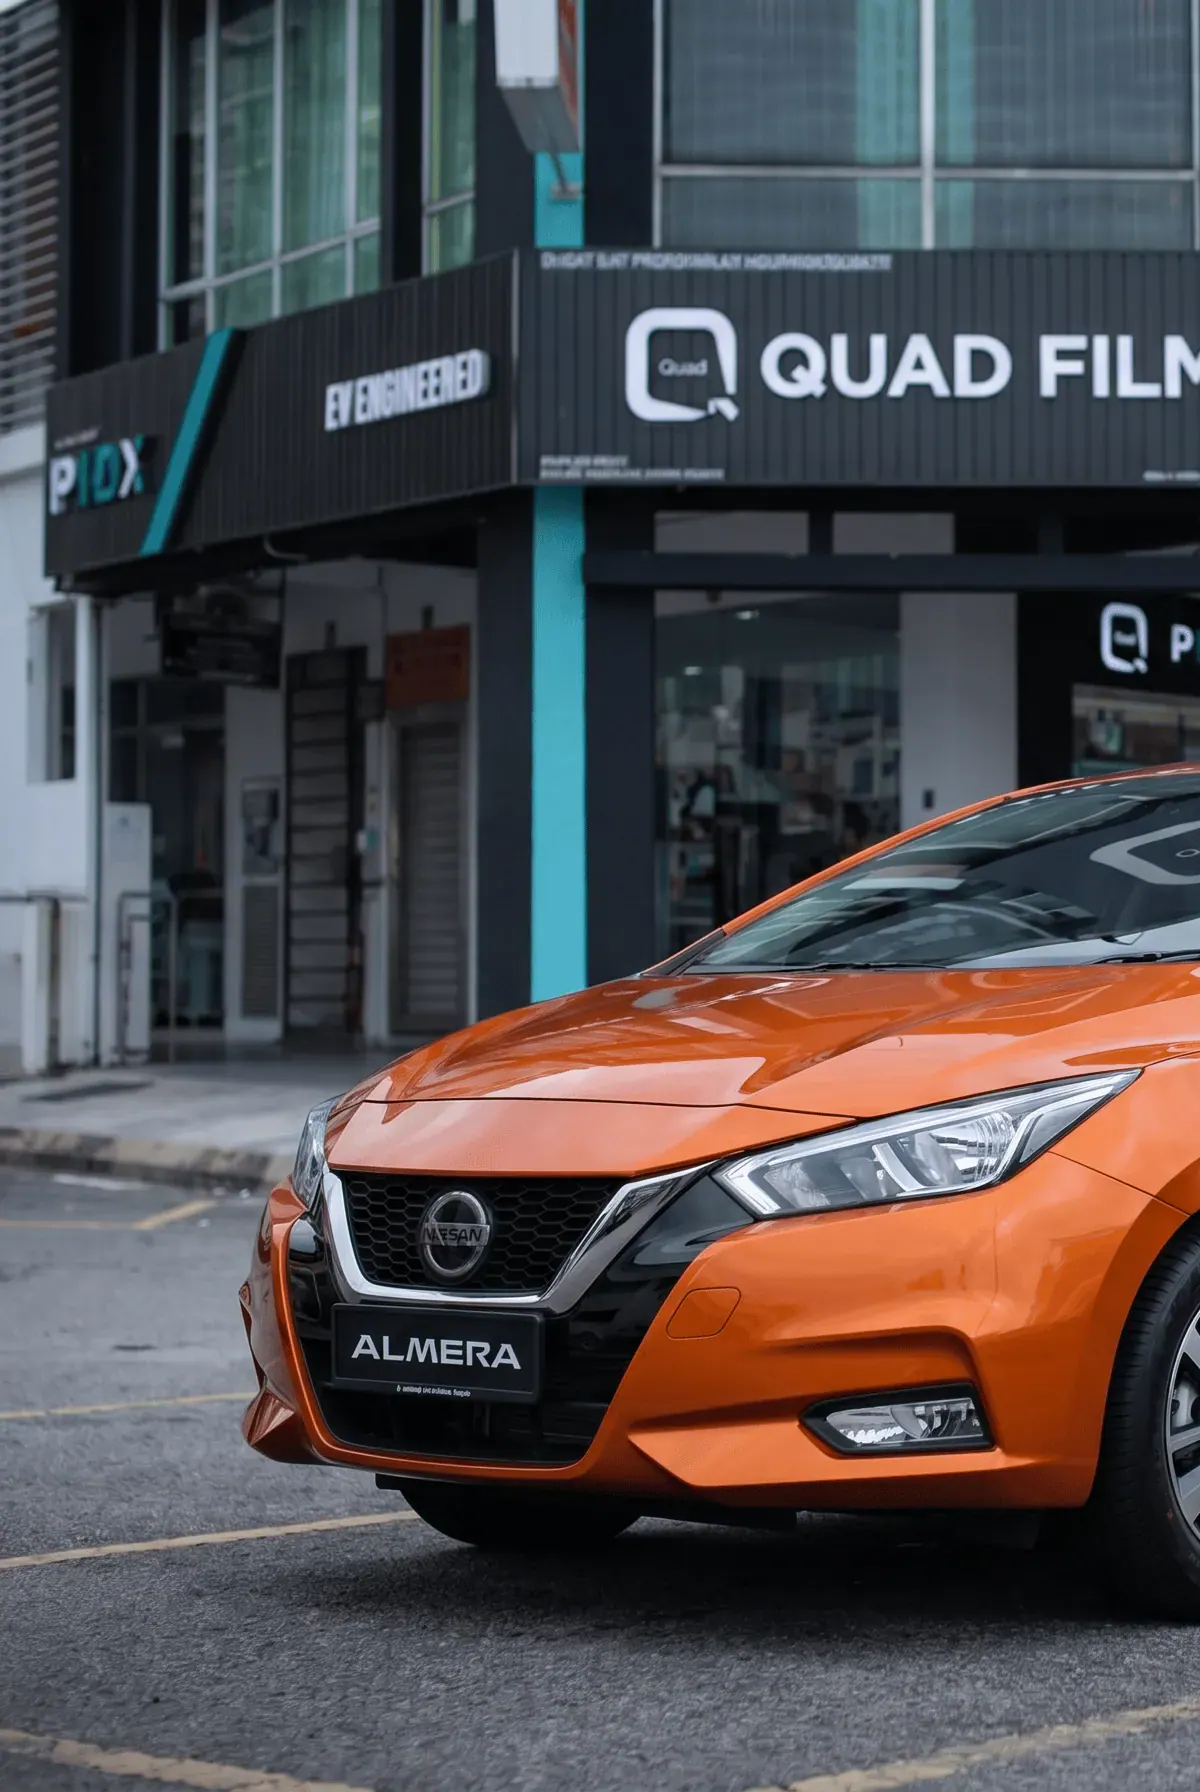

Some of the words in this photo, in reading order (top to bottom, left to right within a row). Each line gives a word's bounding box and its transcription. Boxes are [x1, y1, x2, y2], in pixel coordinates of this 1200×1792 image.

[657, 357, 709, 377] Quad
[760, 331, 1013, 399] QUAD
[351, 1334, 522, 1370] ALMERA
